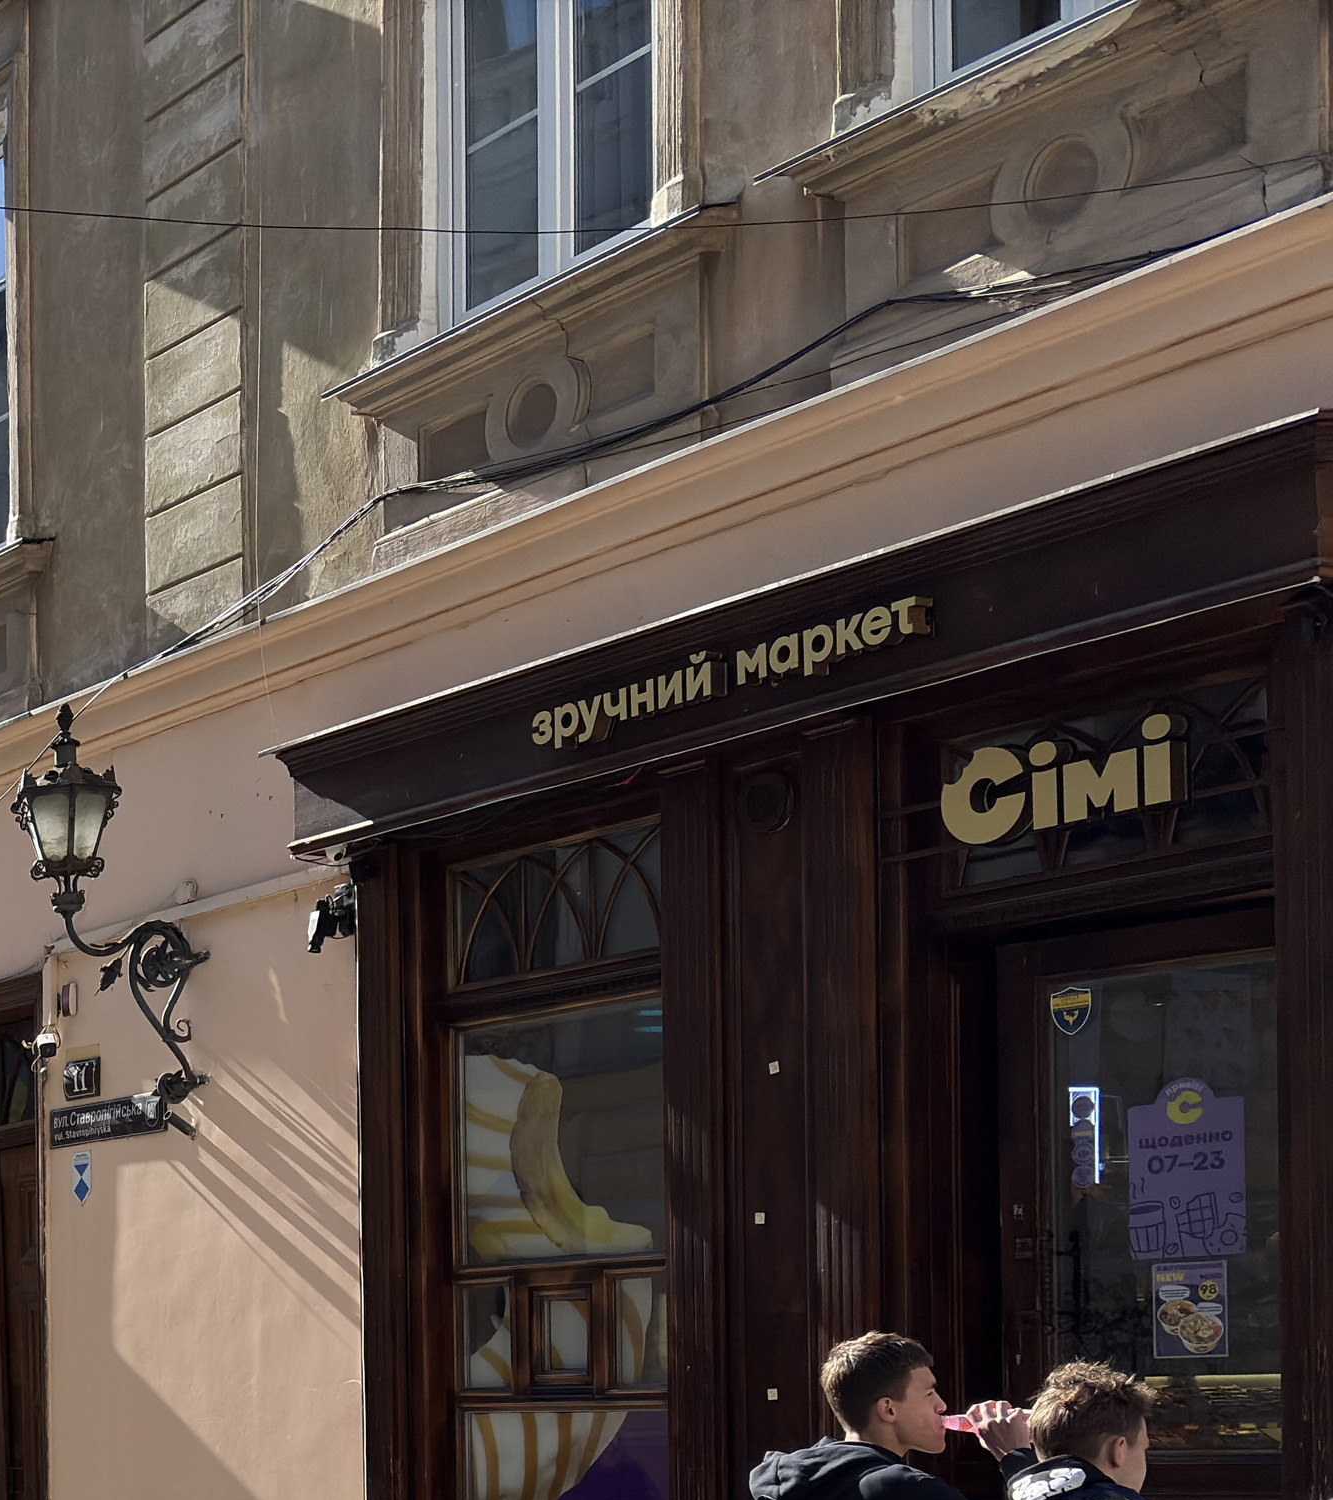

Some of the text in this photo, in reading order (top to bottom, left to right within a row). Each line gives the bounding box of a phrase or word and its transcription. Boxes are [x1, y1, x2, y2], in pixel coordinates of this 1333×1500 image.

[532, 595, 925, 749] зручний маркет
[940, 713, 1173, 845] Сімі
[1138, 1130, 1233, 1150] щоденно
[1199, 1284, 1217, 1295] 98
